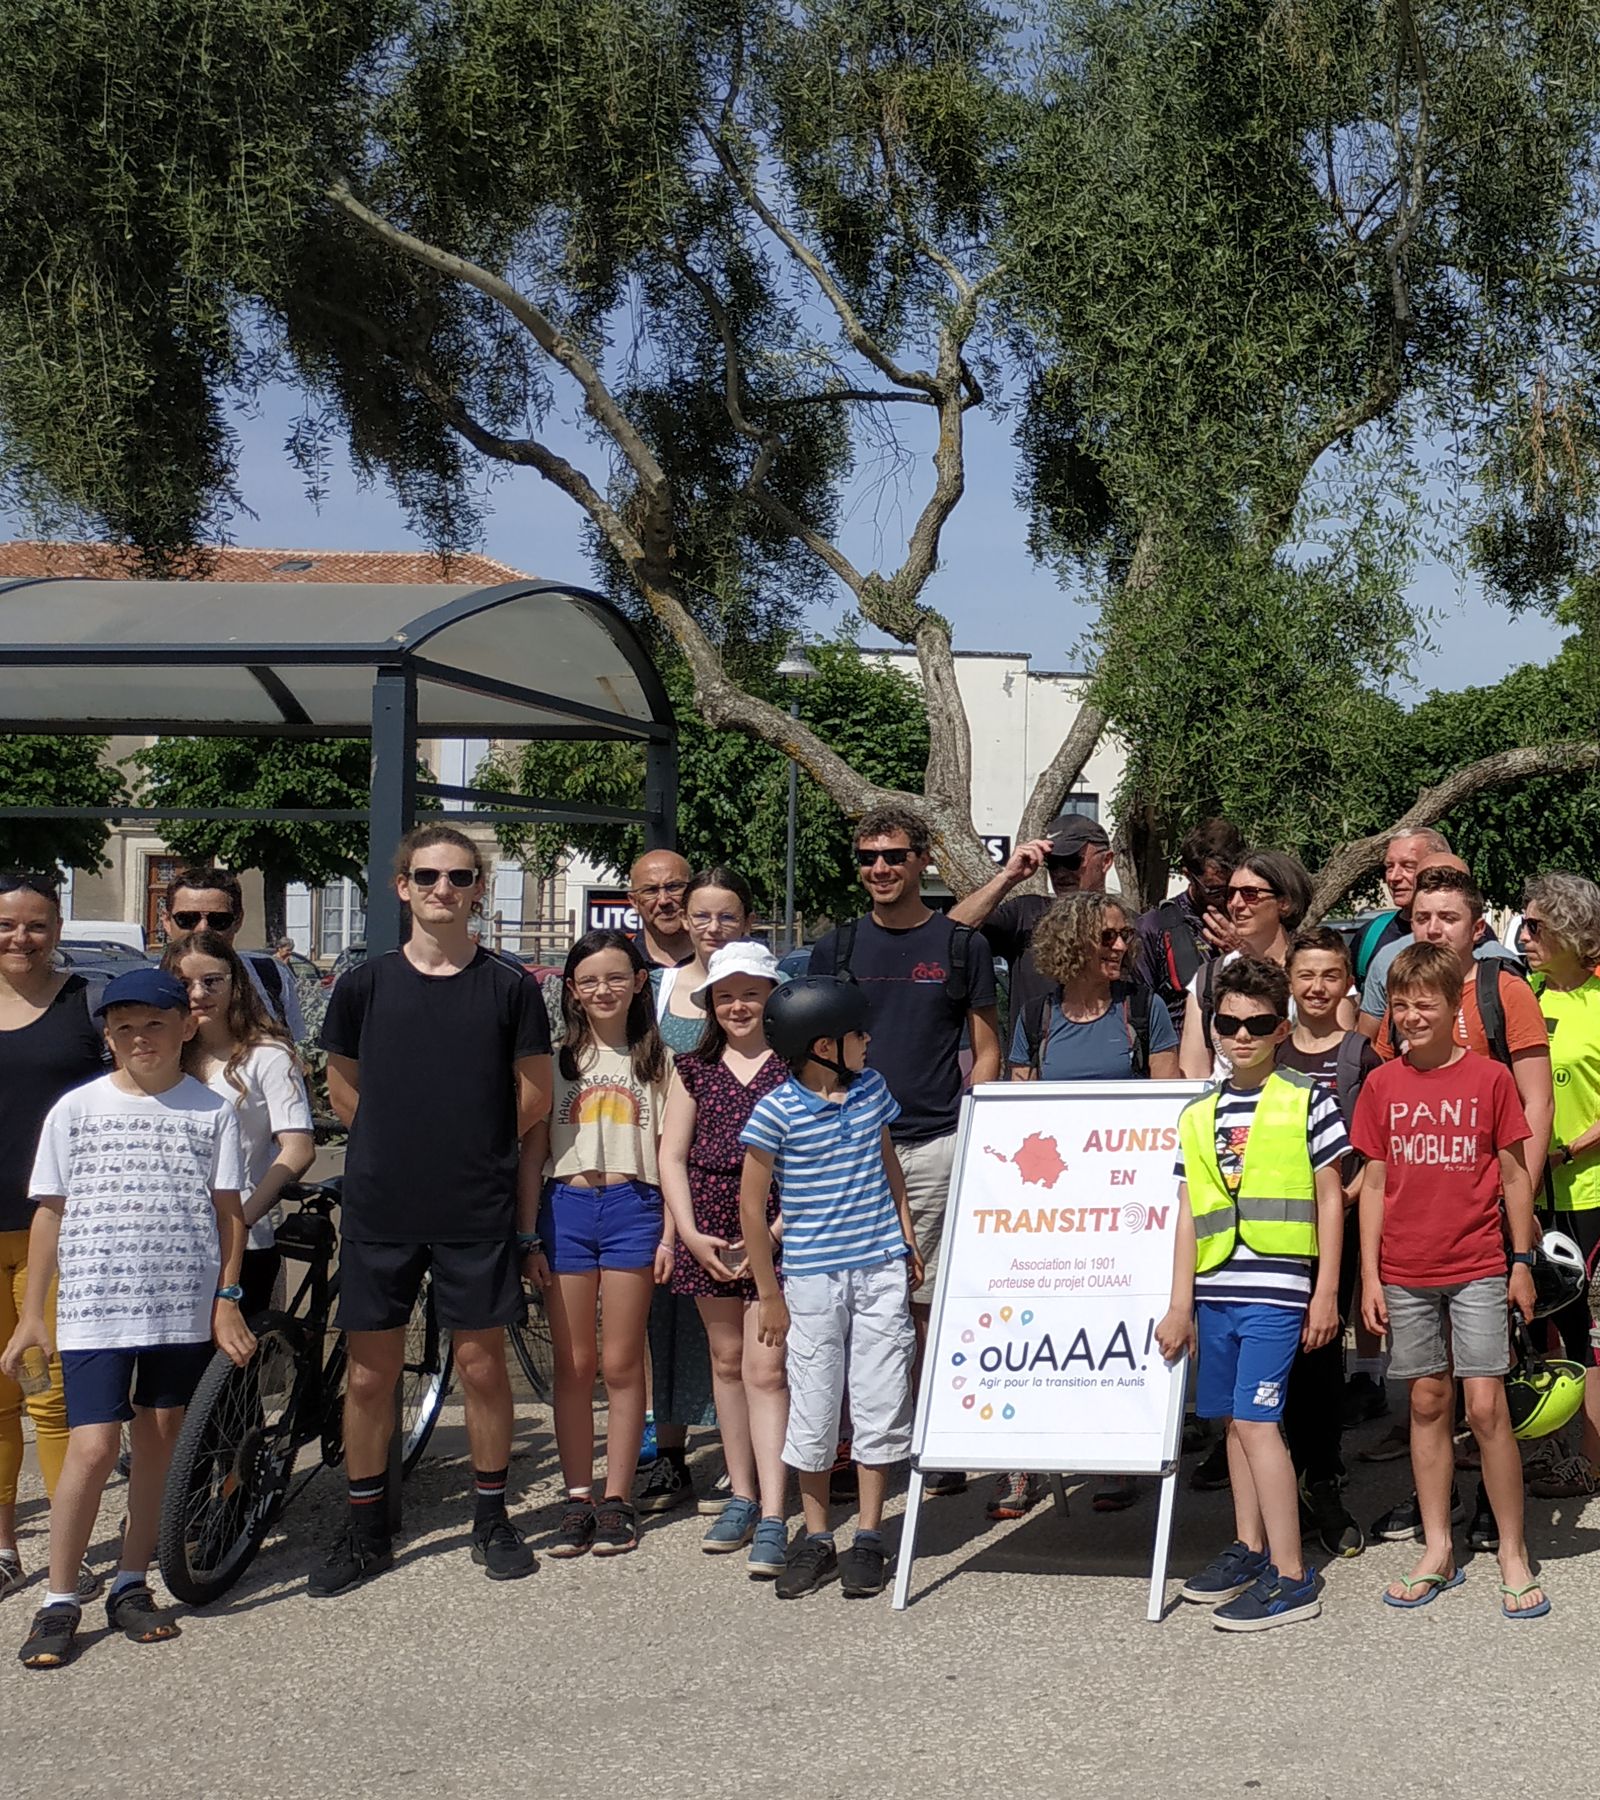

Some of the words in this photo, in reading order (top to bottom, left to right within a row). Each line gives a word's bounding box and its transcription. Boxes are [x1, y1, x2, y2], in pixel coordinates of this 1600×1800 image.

[591, 907, 644, 929] LITE
[1556, 1072, 1567, 1083] U
[584, 1074, 628, 1088] BEACH
[629, 1082, 650, 1131] SOCIETY
[1082, 1127, 1177, 1152] AUNIS
[1390, 1133, 1478, 1166] PWOBLEM
[1110, 1169, 1137, 1185] EN
[973, 1202, 1169, 1234] TRANSITION
[1010, 1258, 1071, 1270] Association
[1074, 1257, 1087, 1270] loi
[1090, 1256, 1115, 1270] 1901
[988, 1276, 1035, 1291] porteuse
[1037, 1275, 1051, 1288] du
[1053, 1274, 1084, 1291] projet
[1087, 1273, 1132, 1288] OUAAA!
[979, 1377, 1002, 1389] Agir
[1004, 1379, 1029, 1389] pour
[1032, 1376, 1042, 1387] la
[1046, 1376, 1097, 1387] transition
[1100, 1379, 1114, 1387] en
[1117, 1376, 1145, 1387] Aunis
